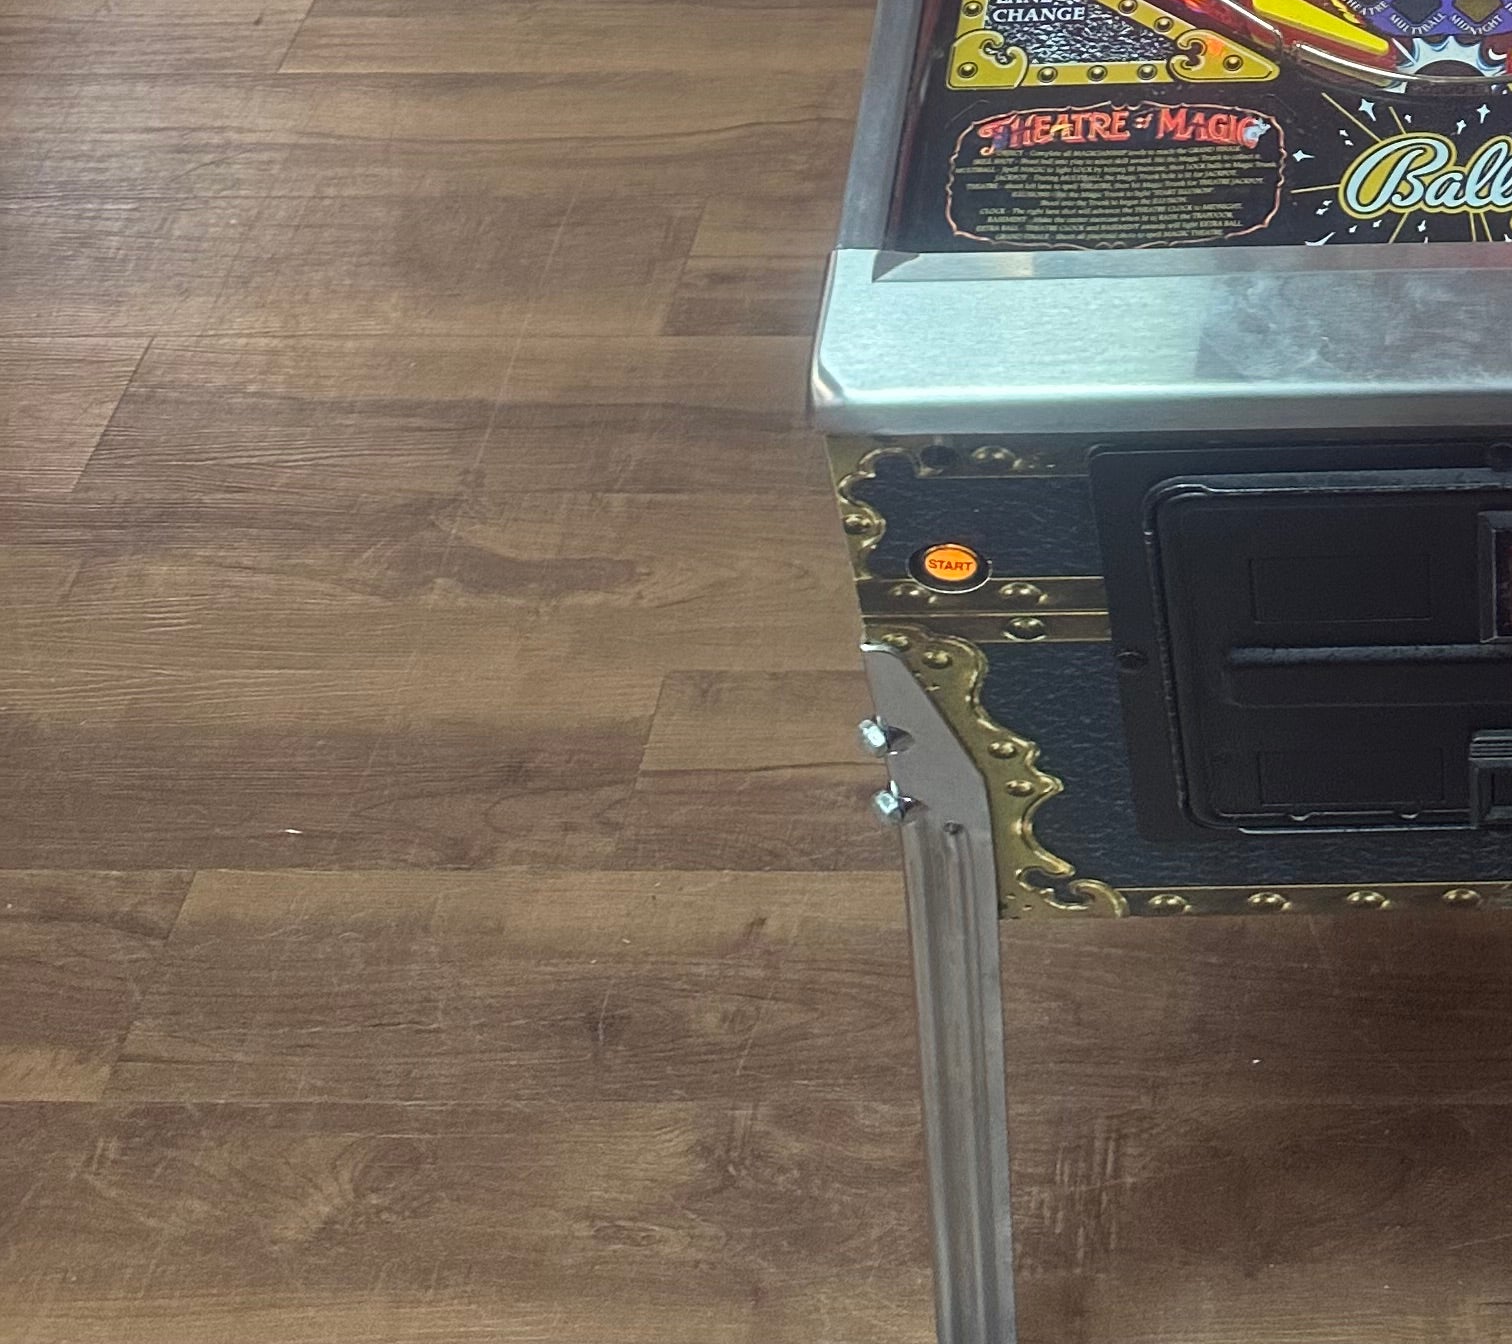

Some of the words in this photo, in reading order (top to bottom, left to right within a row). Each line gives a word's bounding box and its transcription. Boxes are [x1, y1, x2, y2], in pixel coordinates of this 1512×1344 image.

[991, 5, 1086, 23] CHANGE
[1389, 12, 1448, 35] MULTIBALL
[1450, 12, 1505, 35] MIDNIGHT
[976, 108, 1131, 156] THEATRE
[1156, 107, 1259, 149] MAGIC
[928, 558, 974, 572] START
